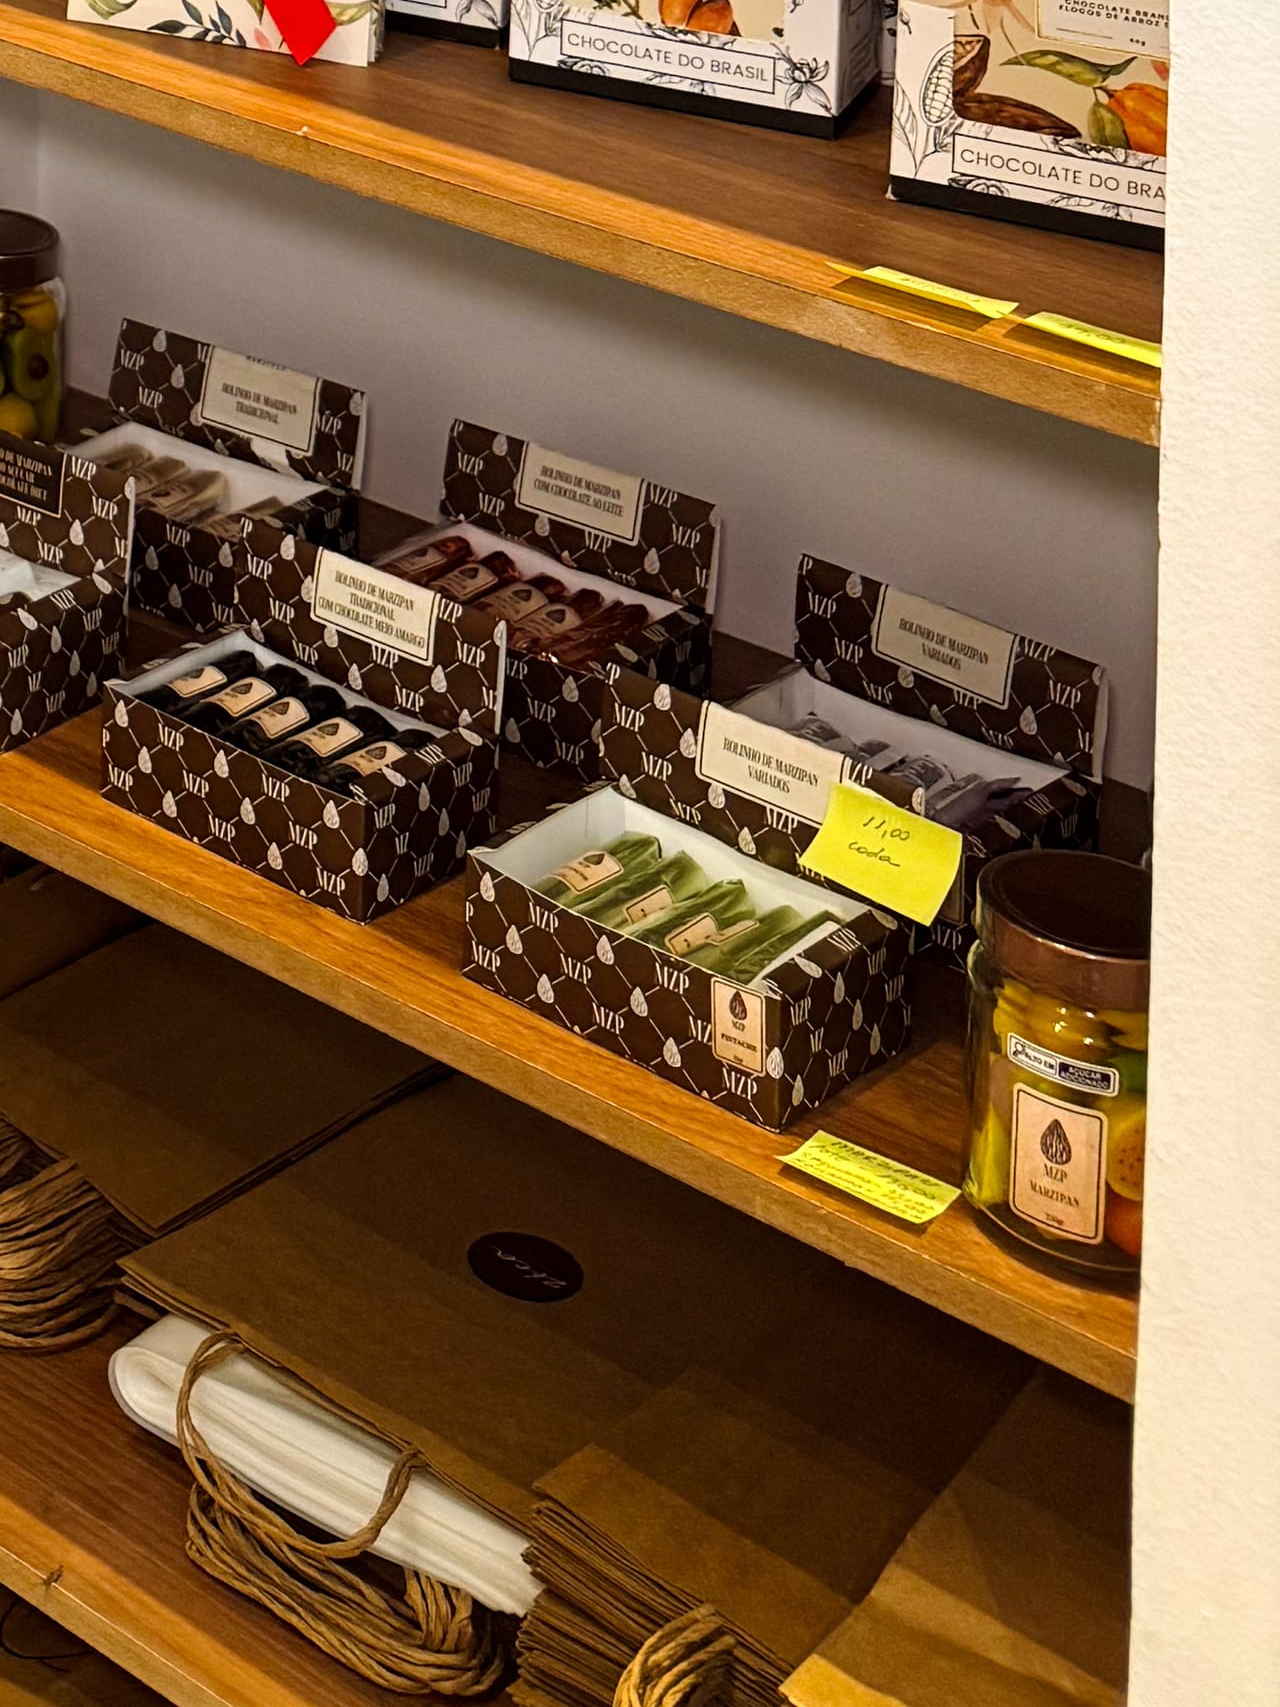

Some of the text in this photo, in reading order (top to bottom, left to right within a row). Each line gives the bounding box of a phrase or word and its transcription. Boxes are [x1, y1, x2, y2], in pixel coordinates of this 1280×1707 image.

[568, 33, 768, 83] CHOCOLATE DO BRASIL
[960, 148, 1082, 185] CHOCOLATE
[1089, 174, 1120, 193] DO
[158, 725, 184, 753] MZP
[722, 735, 761, 764] BOLINHO
[774, 756, 820, 788] MARZIPAN
[746, 764, 791, 795] VARIADOS
[528, 901, 559, 933] MZP
[559, 952, 592, 986] MZP
[655, 962, 689, 994] MZP
[722, 1066, 758, 1100] MZP
